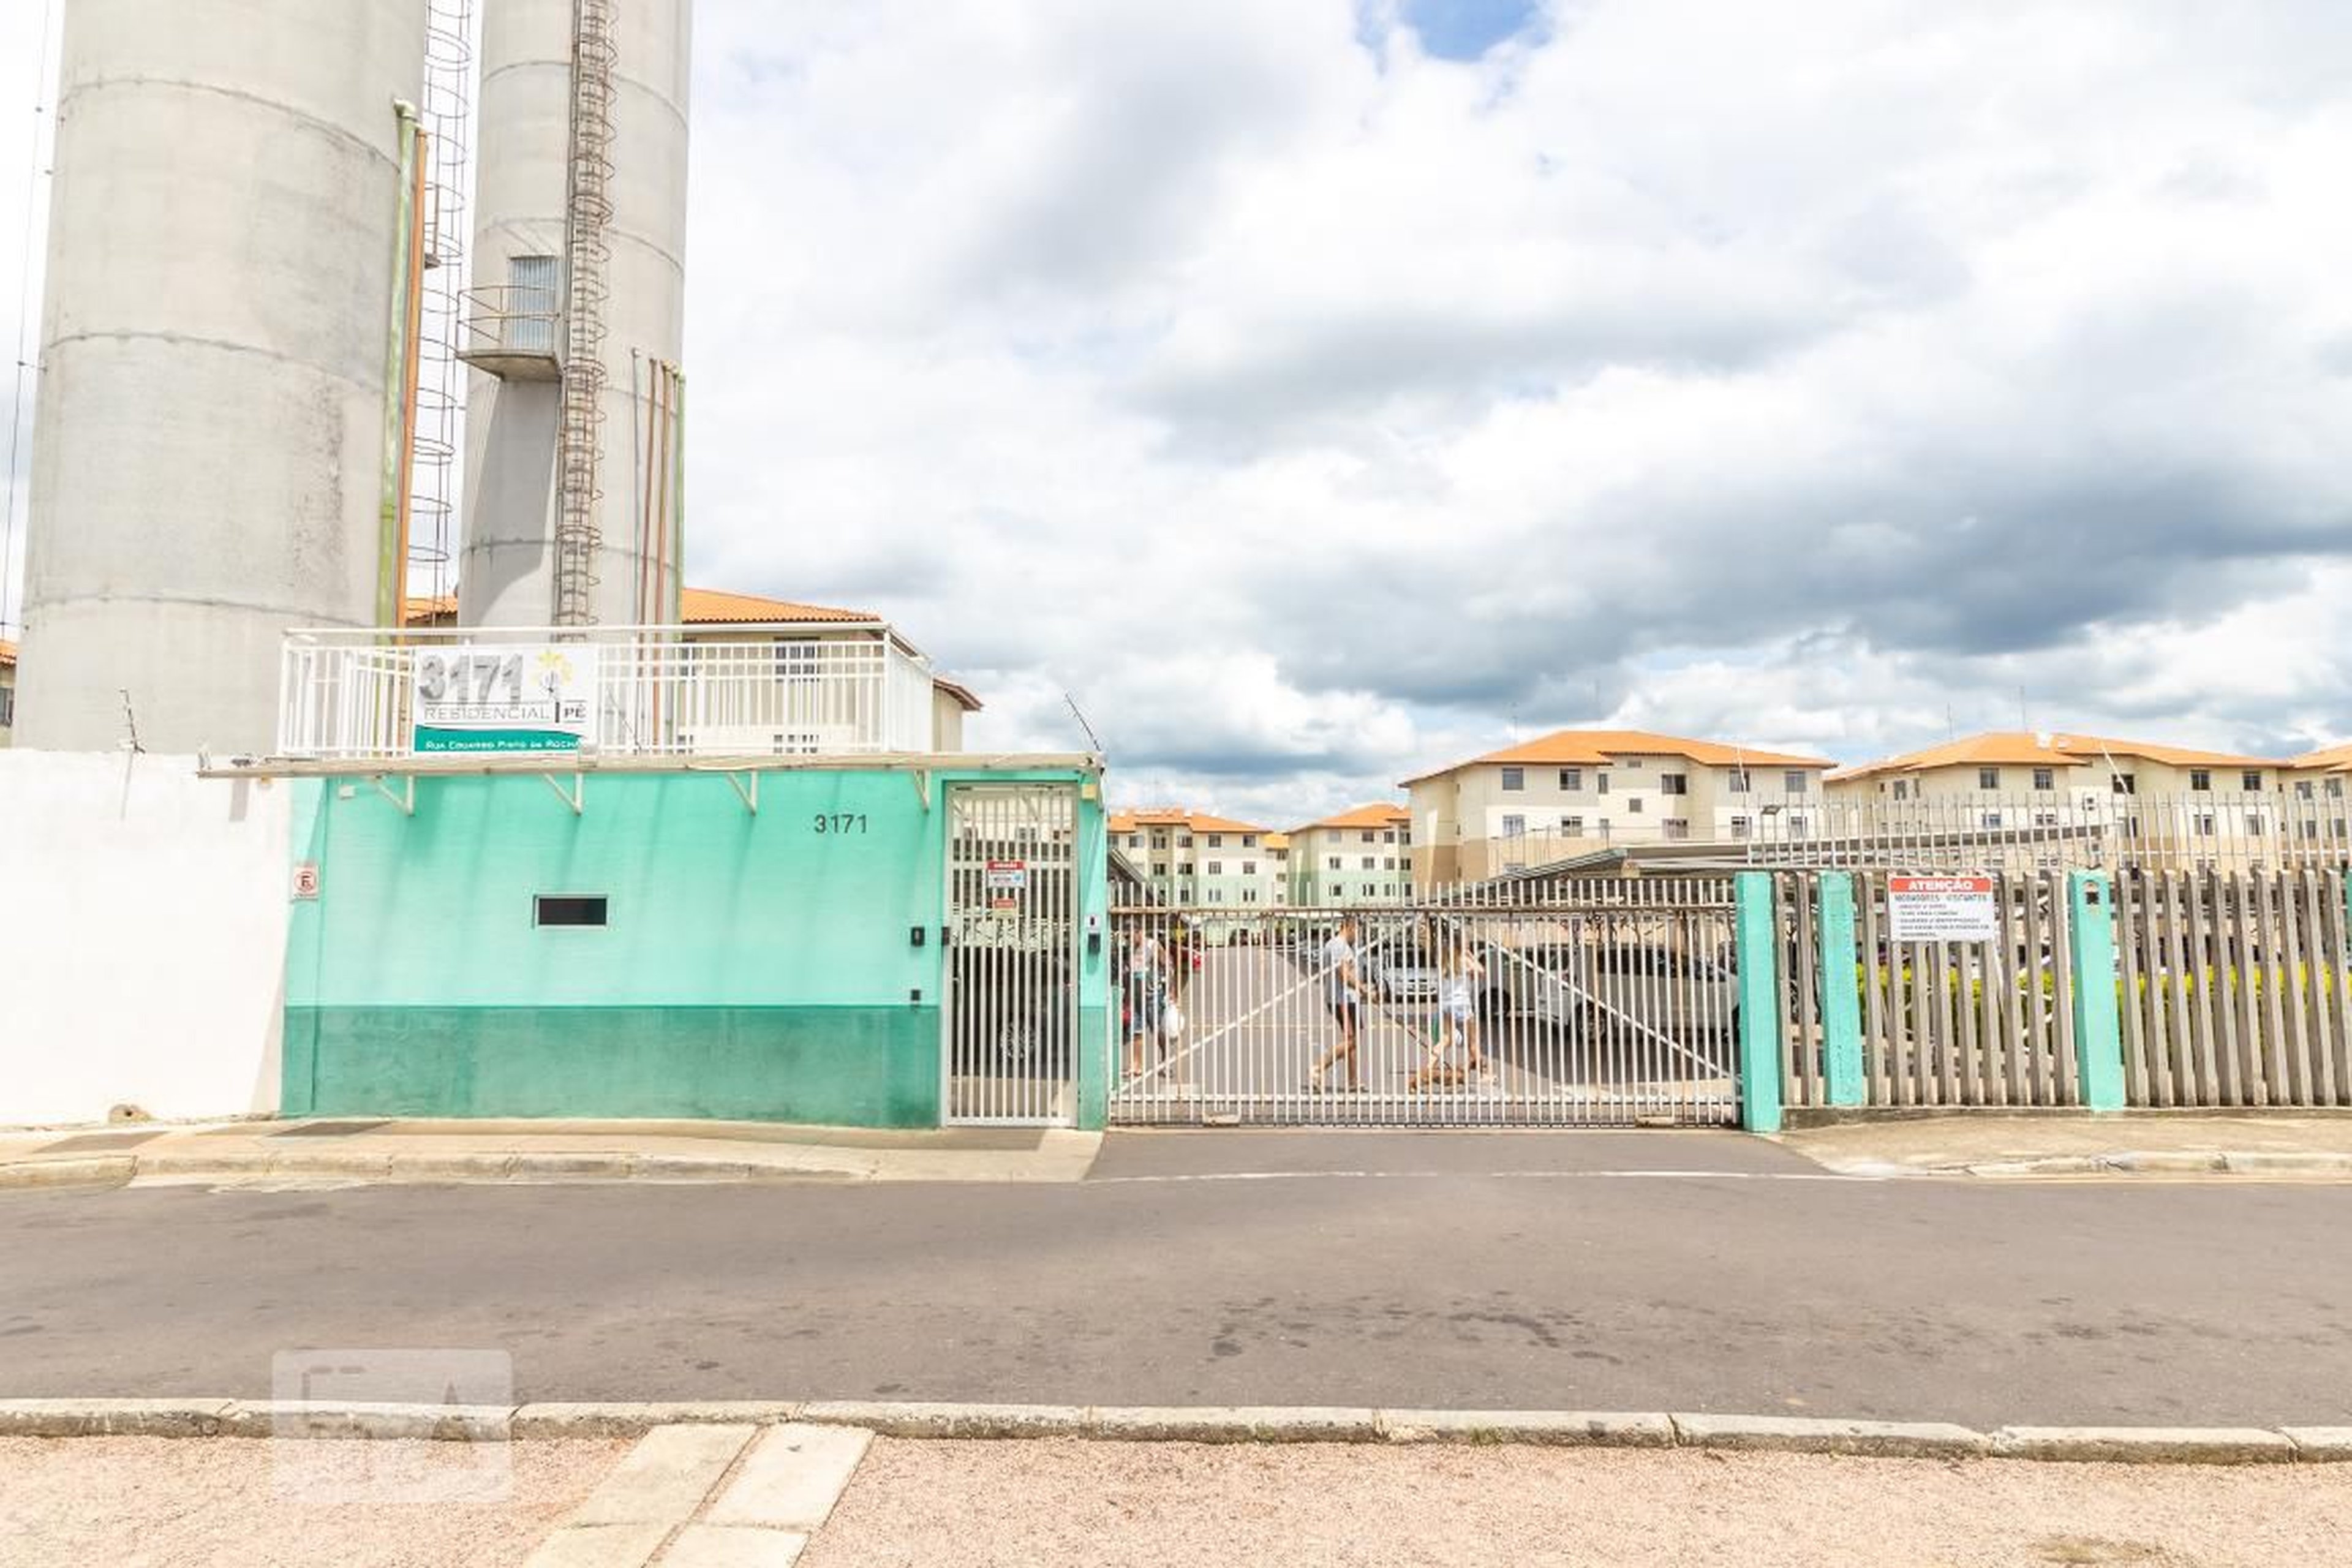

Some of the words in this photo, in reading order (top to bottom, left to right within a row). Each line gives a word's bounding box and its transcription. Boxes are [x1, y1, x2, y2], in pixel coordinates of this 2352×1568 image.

[419, 654, 522, 705] 3171
[424, 706, 550, 720] RESIDENCIAL
[815, 814, 866, 834] 3171
[1909, 879, 1973, 892] ATENÇÃO
